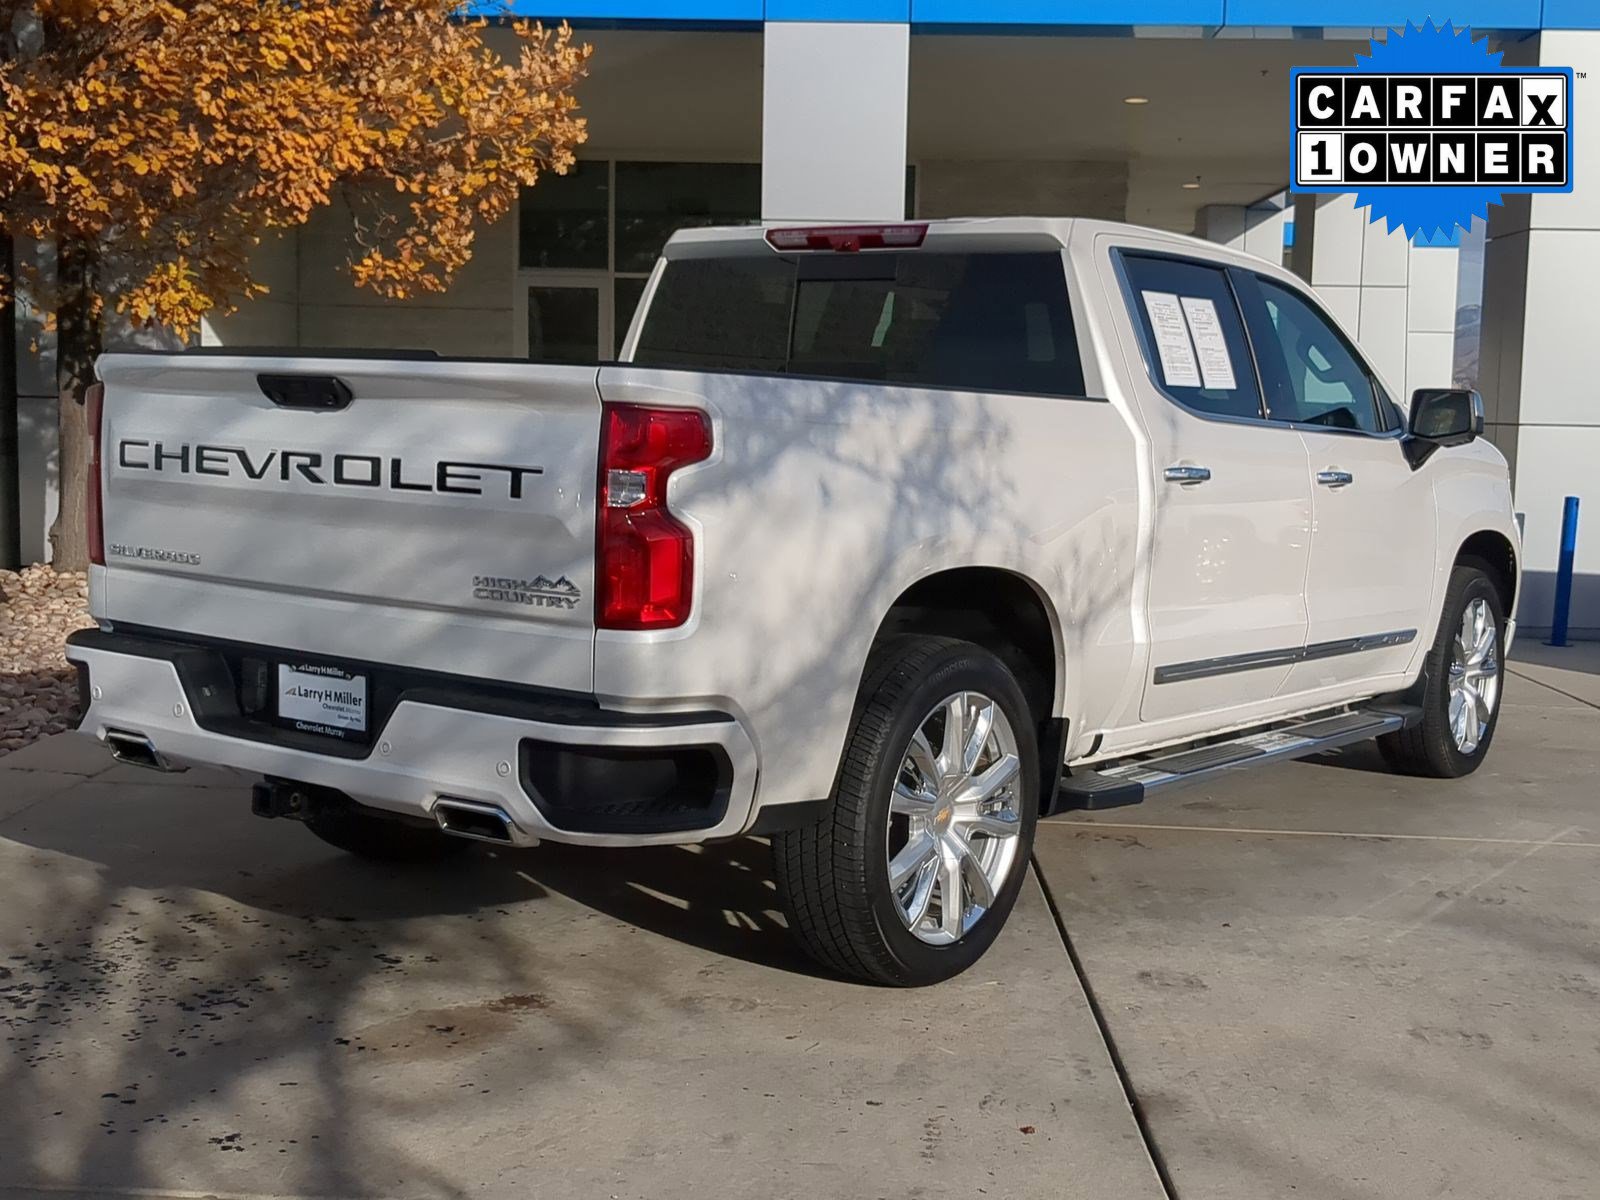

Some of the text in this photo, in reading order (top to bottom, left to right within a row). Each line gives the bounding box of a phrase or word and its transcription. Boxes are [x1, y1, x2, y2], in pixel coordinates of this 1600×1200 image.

[119, 439, 544, 499] CHEVROLET
[472, 575, 528, 590] HIGH
[473, 587, 581, 610] COUNTRY
[305, 663, 320, 674] Larry
[327, 667, 344, 676] Miller
[297, 685, 362, 707] Larry H Miller
[296, 721, 345, 738] Chevrolet Murray
